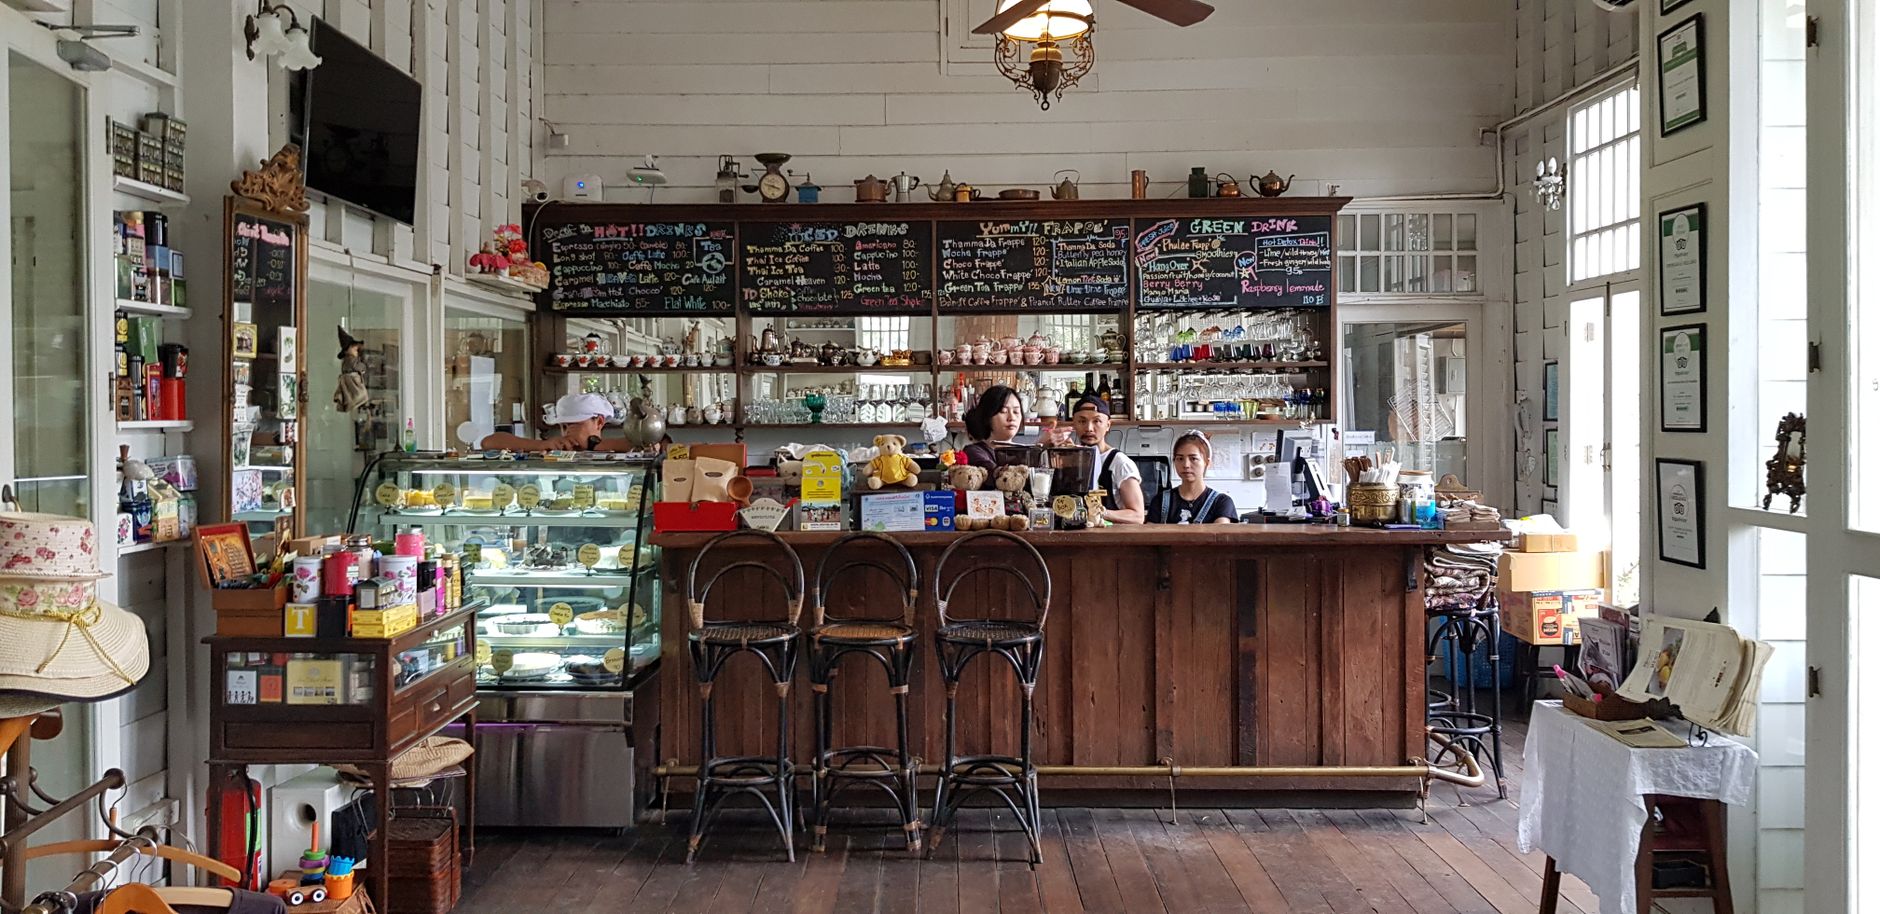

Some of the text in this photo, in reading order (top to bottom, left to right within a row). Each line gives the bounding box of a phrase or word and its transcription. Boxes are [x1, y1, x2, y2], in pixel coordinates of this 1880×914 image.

[1190, 219, 1244, 233] GREEN
[756, 275, 794, 286] Caramel
[1143, 279, 1203, 291] Berry Berry
[291, 609, 309, 630] T
